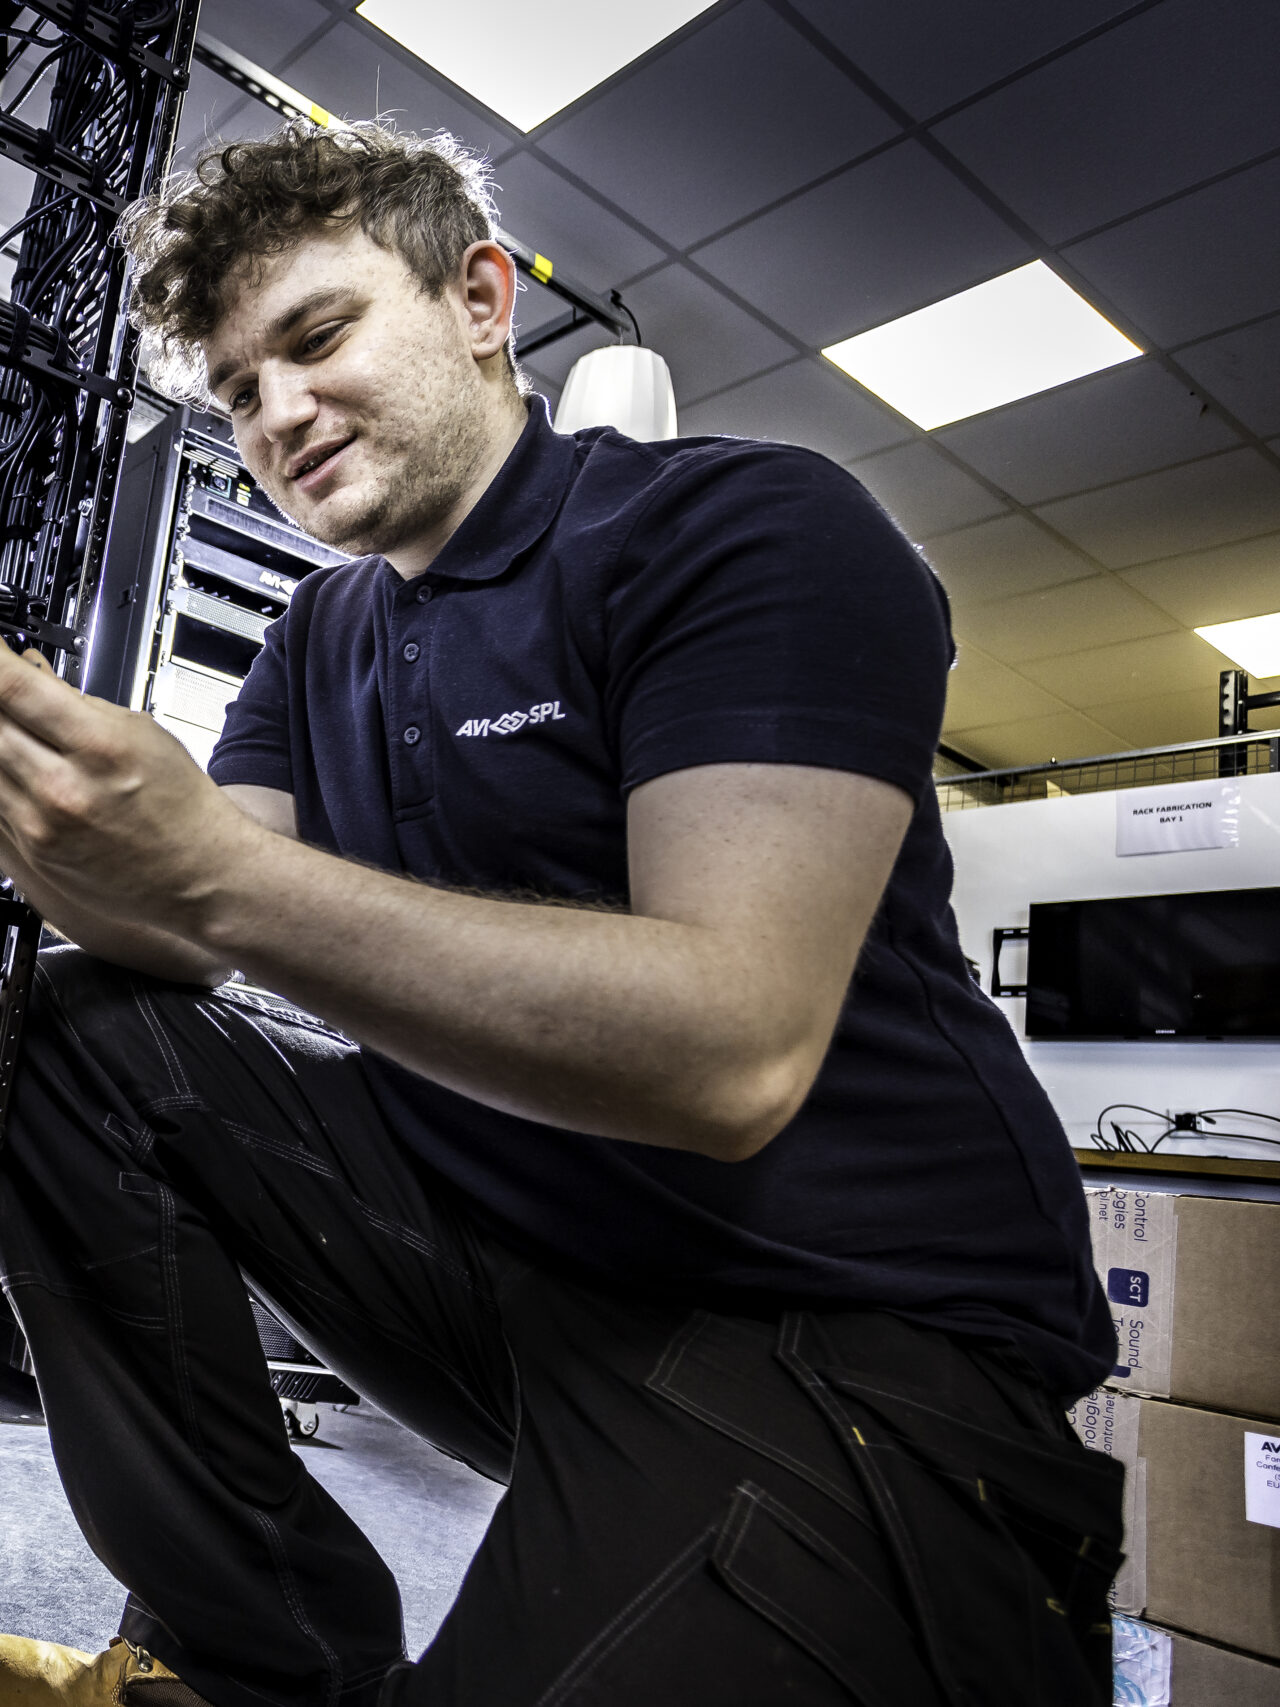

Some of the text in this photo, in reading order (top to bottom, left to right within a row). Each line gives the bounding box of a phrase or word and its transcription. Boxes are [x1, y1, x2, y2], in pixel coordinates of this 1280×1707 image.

[528, 701, 566, 724] SPL
[1132, 801, 1212, 816] RACK FABRICATION
[1159, 815, 1177, 824] BAY
[1129, 1275, 1142, 1302] SCT
[1128, 1319, 1144, 1369] Sound
